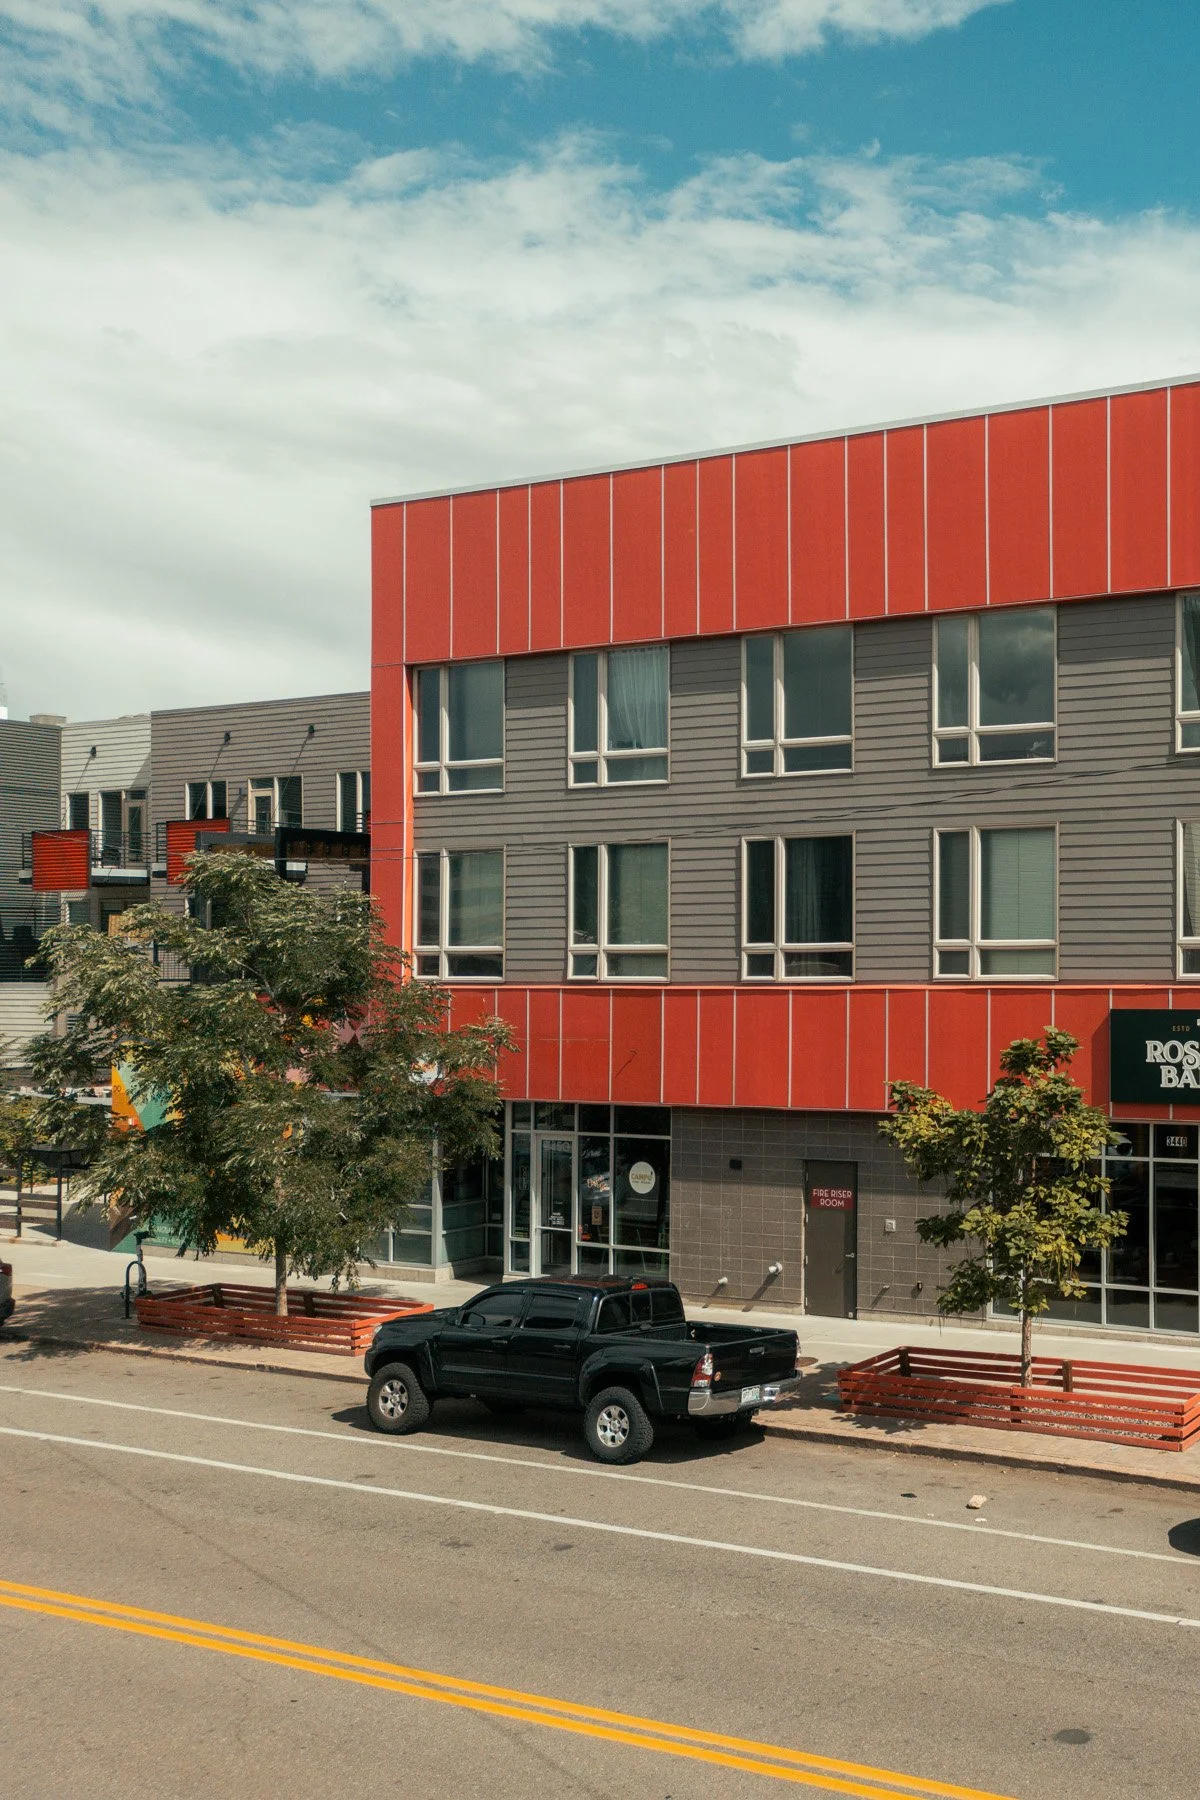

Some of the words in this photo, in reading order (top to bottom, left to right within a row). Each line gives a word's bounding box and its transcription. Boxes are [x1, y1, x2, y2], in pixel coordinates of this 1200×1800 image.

[1167, 1135, 1187, 1146] 3440
[812, 1188, 829, 1198] FIRE
[830, 1189, 852, 1199] RISER
[820, 1198, 845, 1207] ROOM
